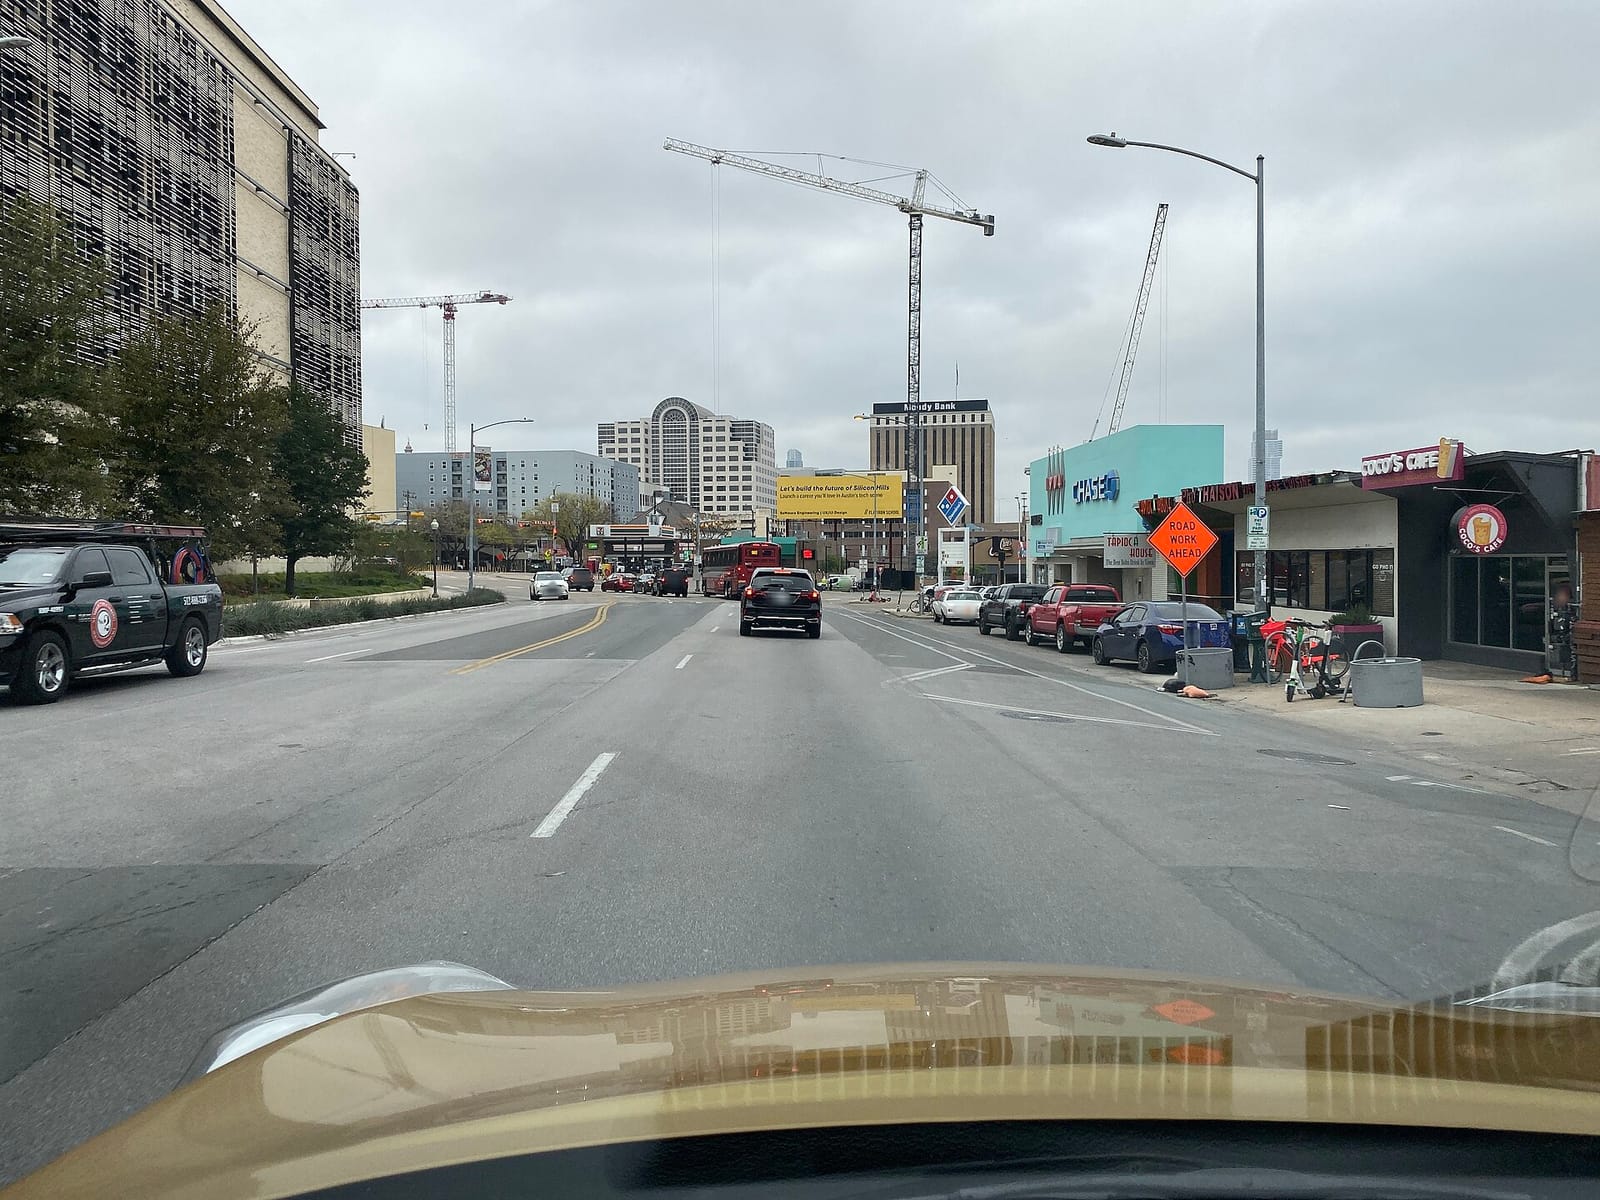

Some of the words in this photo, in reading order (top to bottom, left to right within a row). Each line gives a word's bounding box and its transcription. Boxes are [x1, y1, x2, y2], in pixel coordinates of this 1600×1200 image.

[934, 402, 956, 410] Bank
[1361, 454, 1404, 476] COCO'S
[1405, 451, 1439, 470] CAFE
[1072, 475, 1107, 503] CHASE
[1169, 521, 1195, 531] ROAD
[1107, 534, 1139, 547] TAPIOCA
[1169, 535, 1197, 544] WORK
[1459, 528, 1481, 553] COCO'S
[1483, 537, 1503, 553] CAFE
[1129, 548, 1153, 558] HOUSE
[1168, 549, 1201, 558] AHEAD
